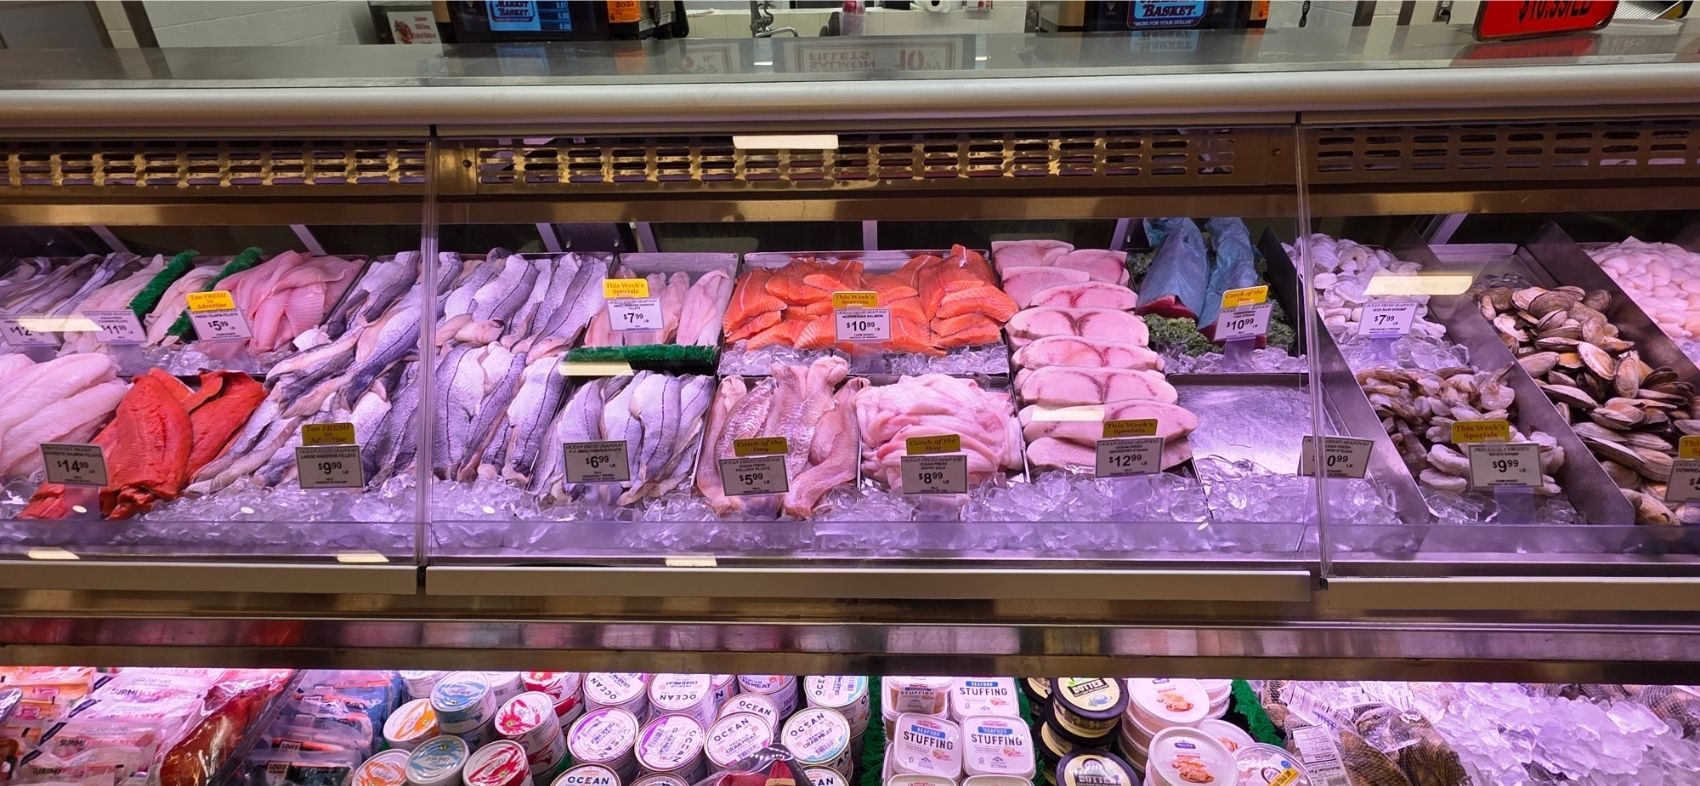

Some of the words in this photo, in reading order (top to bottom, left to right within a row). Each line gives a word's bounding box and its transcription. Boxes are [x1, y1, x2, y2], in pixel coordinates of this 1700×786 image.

[590, 677, 617, 700] OCEAN
[959, 687, 1009, 697] STUFFING
[659, 693, 697, 701] OCEAN
[738, 699, 773, 717] OCEAN
[713, 717, 750, 743] OCEAN
[789, 712, 826, 738] OCEAN
[58, 738, 86, 748] SURIMI
[902, 730, 955, 751] STUFFING
[970, 732, 1024, 748] STUFFING
[566, 775, 611, 786] OCEAN
[810, 776, 835, 786] EAN
